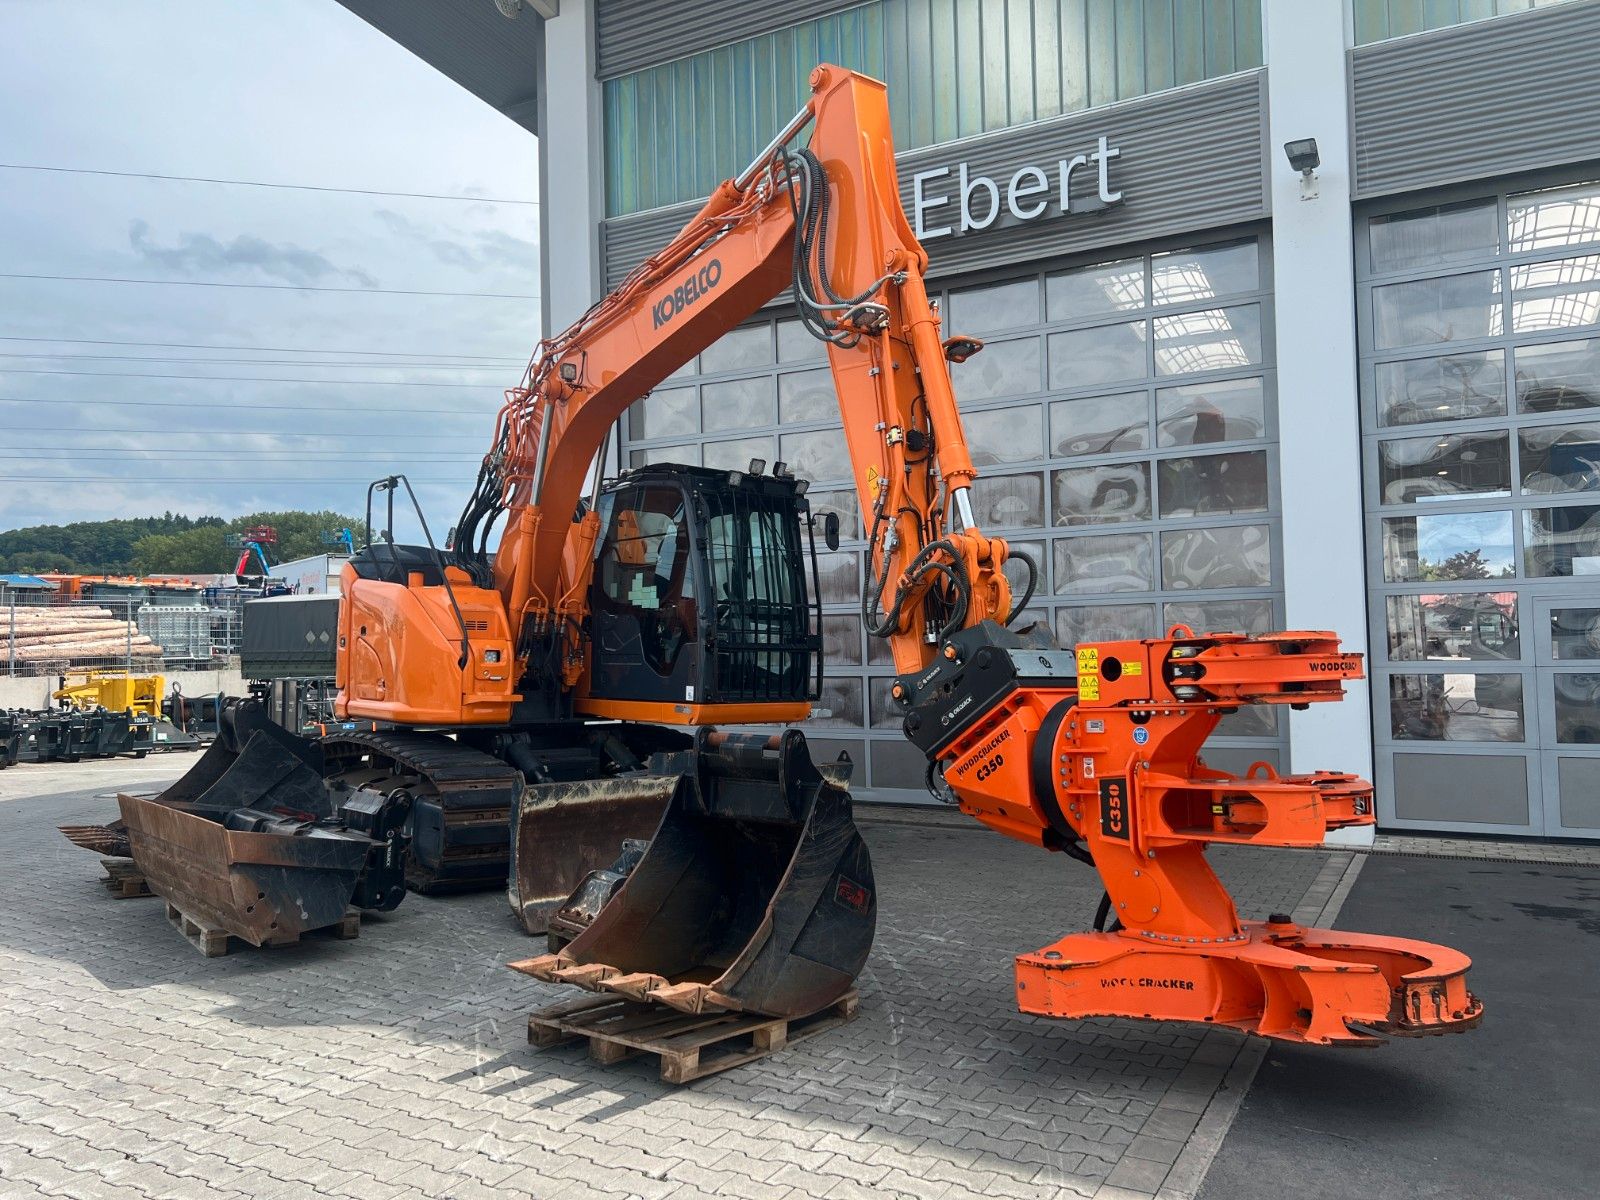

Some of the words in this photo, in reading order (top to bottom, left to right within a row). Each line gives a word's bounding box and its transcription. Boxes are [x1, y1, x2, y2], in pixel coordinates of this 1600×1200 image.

[913, 136, 1123, 240] Ebert
[652, 258, 722, 331] KOBELCO
[956, 729, 1011, 776] WOODCRACKER
[976, 754, 1005, 782] C350
[1109, 783, 1122, 833] C350
